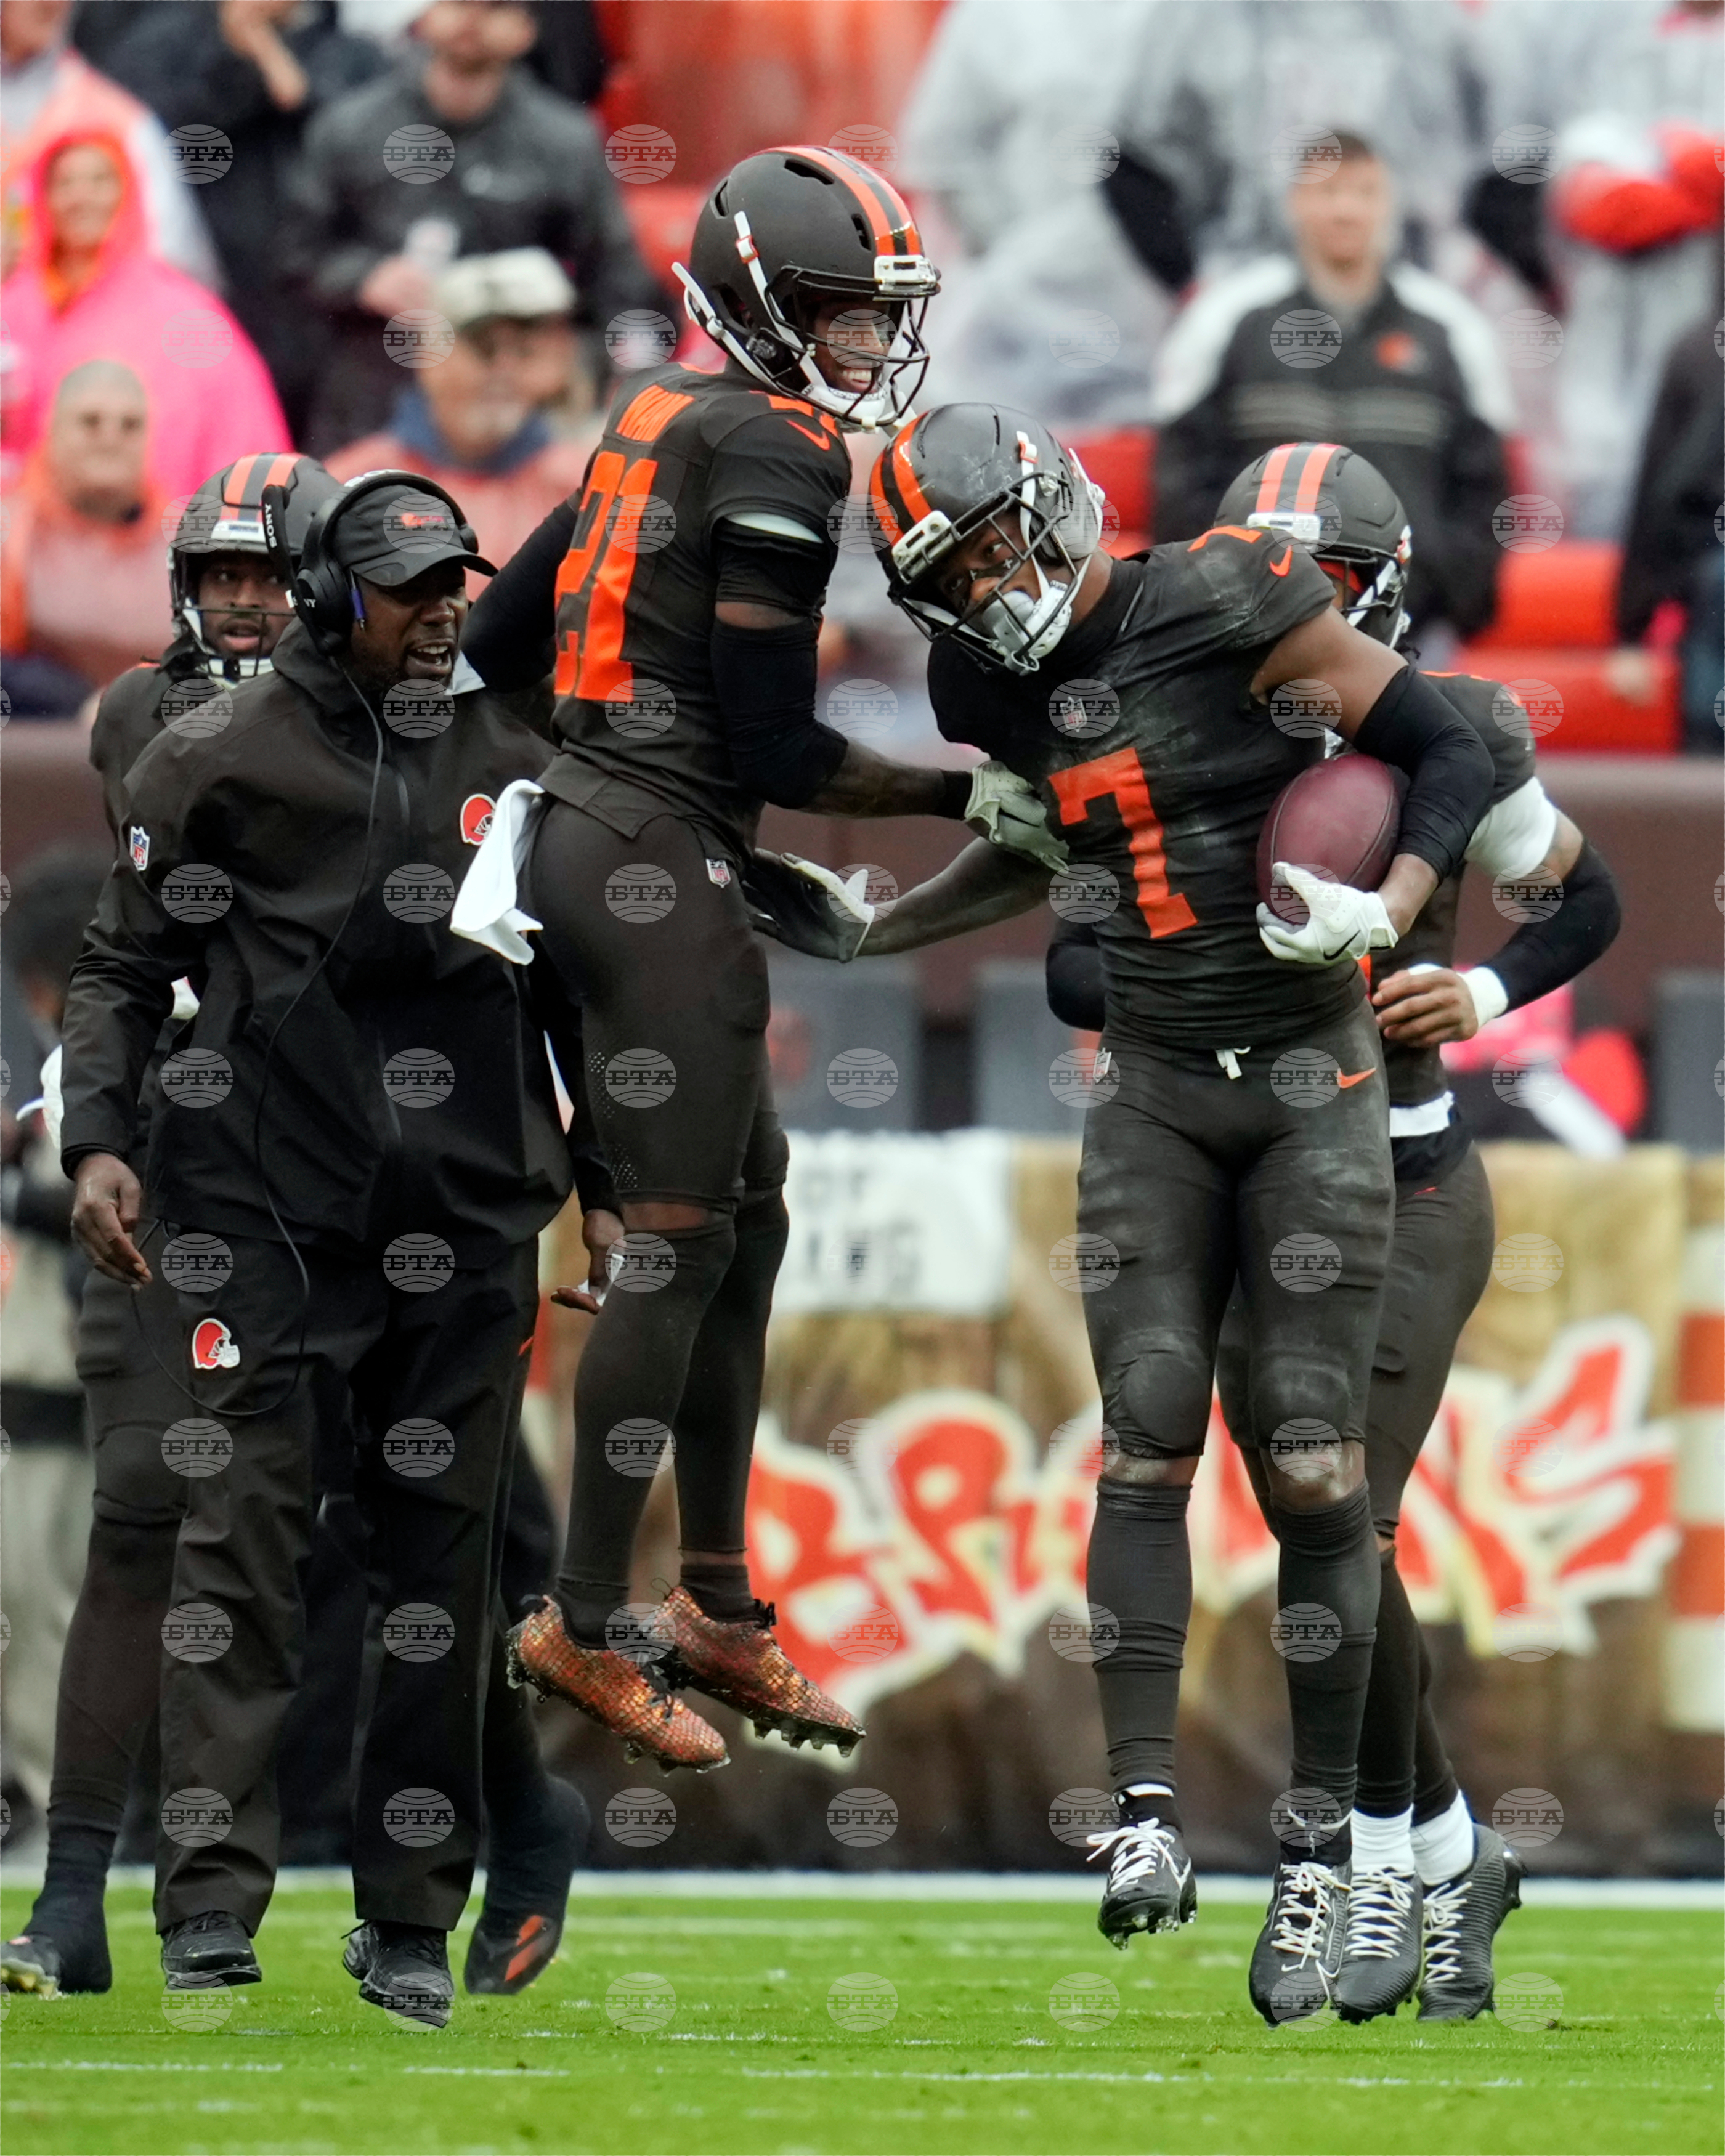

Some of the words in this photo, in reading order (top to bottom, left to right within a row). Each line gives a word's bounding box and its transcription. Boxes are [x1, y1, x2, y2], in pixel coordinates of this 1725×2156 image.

[264, 503, 277, 548] SONY
[554, 450, 658, 702] 21
[1048, 747, 1199, 939] 7
